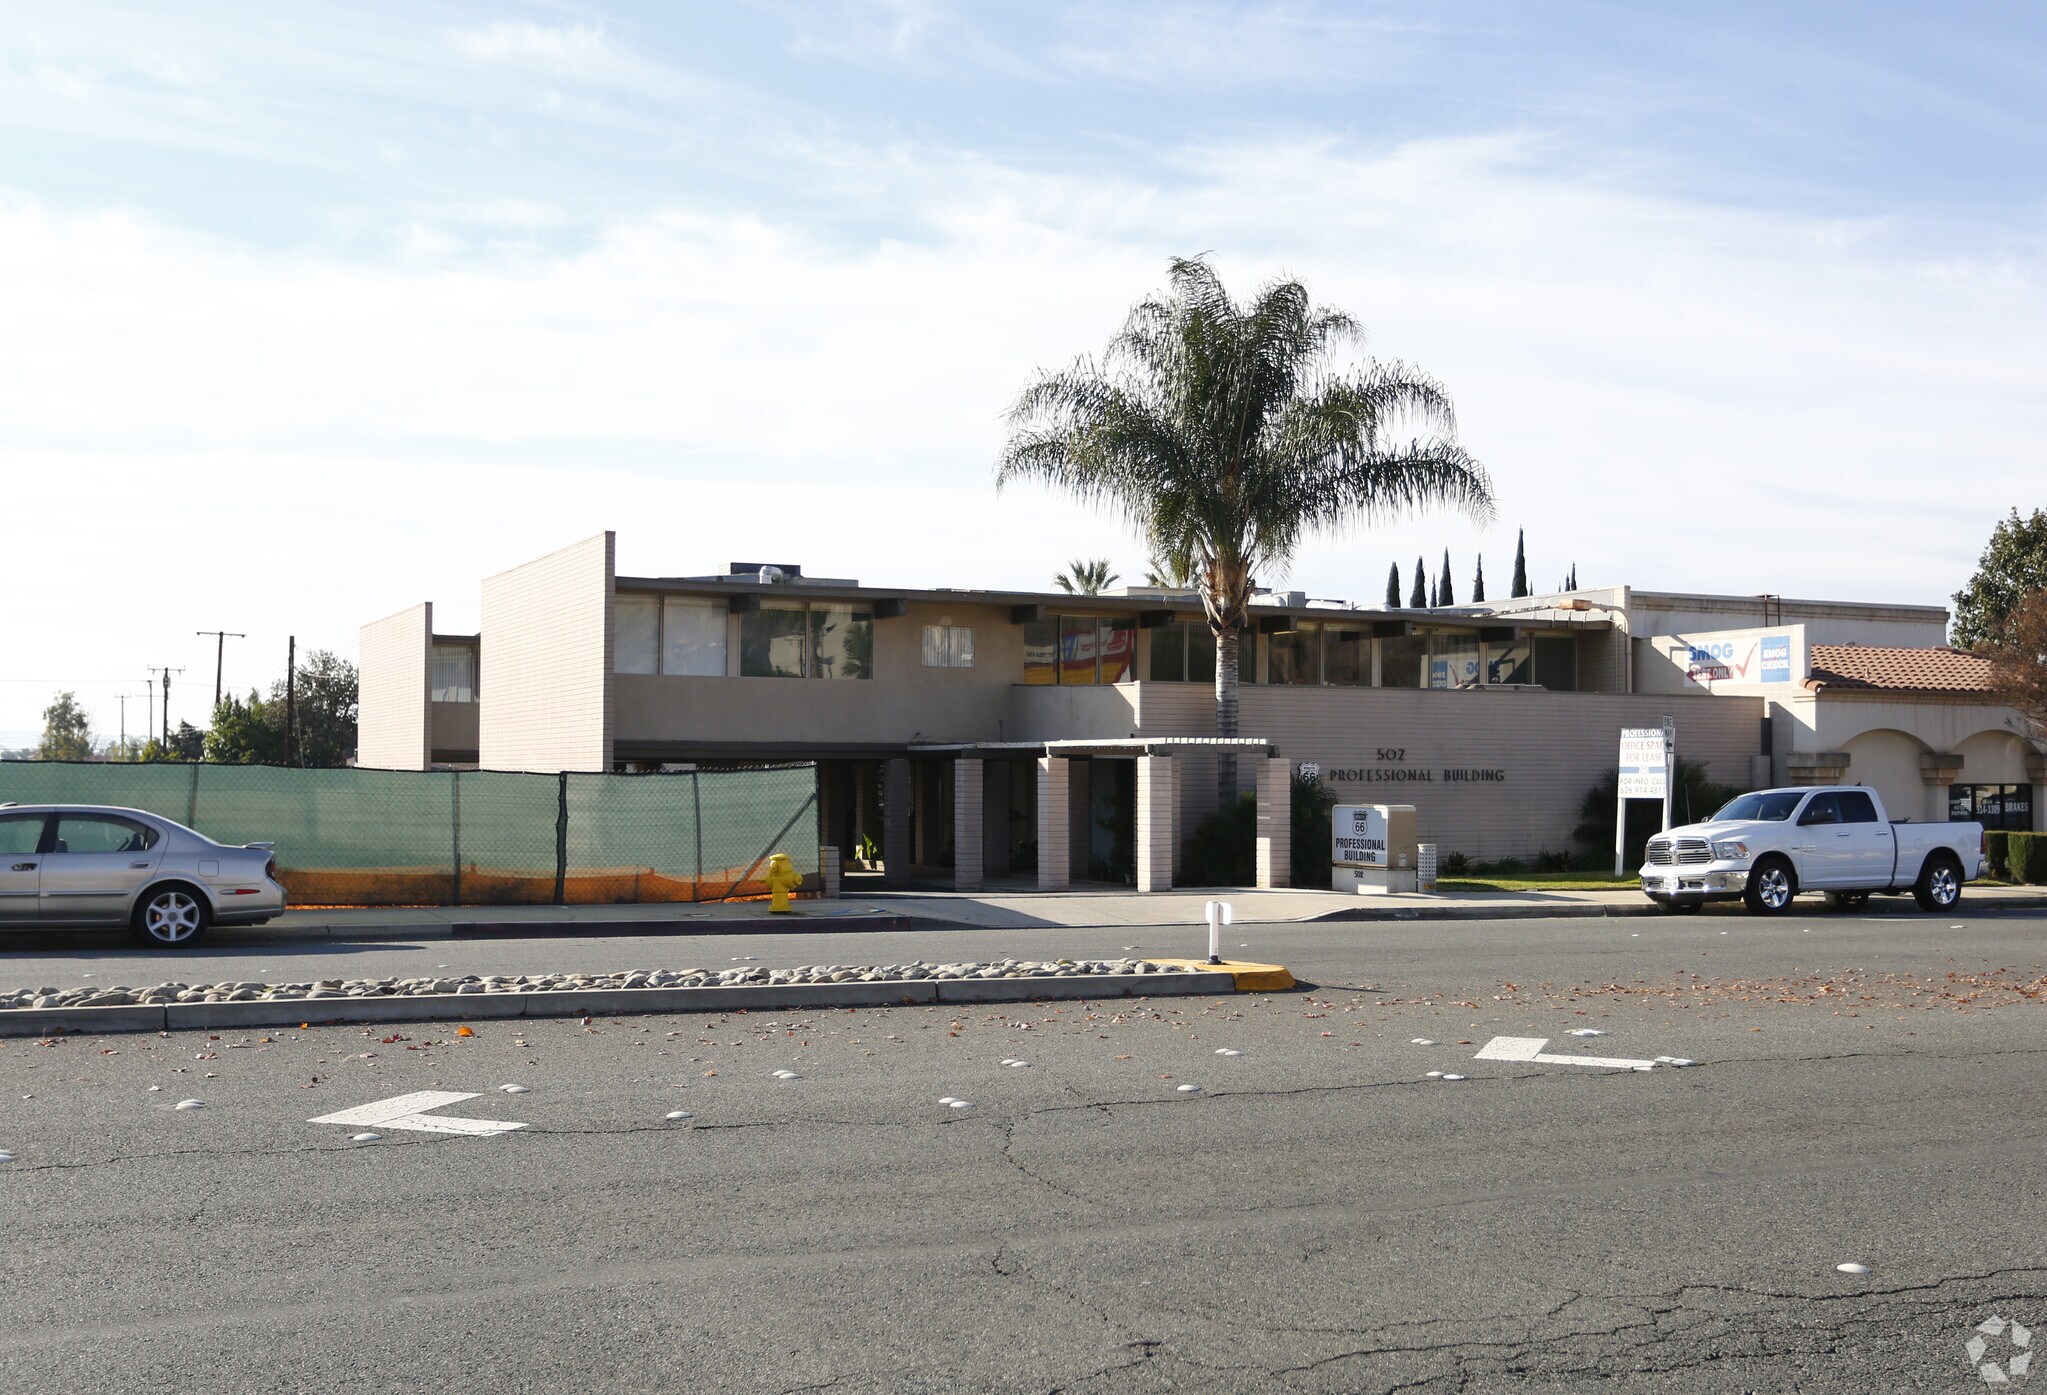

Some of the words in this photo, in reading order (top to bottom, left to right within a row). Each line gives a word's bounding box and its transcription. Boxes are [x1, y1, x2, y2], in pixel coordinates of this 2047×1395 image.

[1689, 642, 1734, 662] SMOG
[1763, 648, 1787, 659] SMOG
[1761, 659, 1789, 670] CHECK
[1712, 667, 1733, 679] ONLY
[1621, 741, 1644, 750] OFFICE
[1646, 741, 1665, 750] SPAC
[1377, 748, 1405, 761] 502
[1626, 752, 1640, 762] FOR
[1642, 752, 1663, 762] LEASE
[1330, 768, 1433, 782] PROFESSIONAL
[1443, 768, 1505, 782] BUILDING
[2004, 801, 2029, 813] BRAKES
[1355, 822, 1365, 832] 66
[1336, 838, 1385, 851] PROFESSIONAL
[1344, 850, 1376, 862] BUILDING
[1354, 870, 1364, 879] 502
